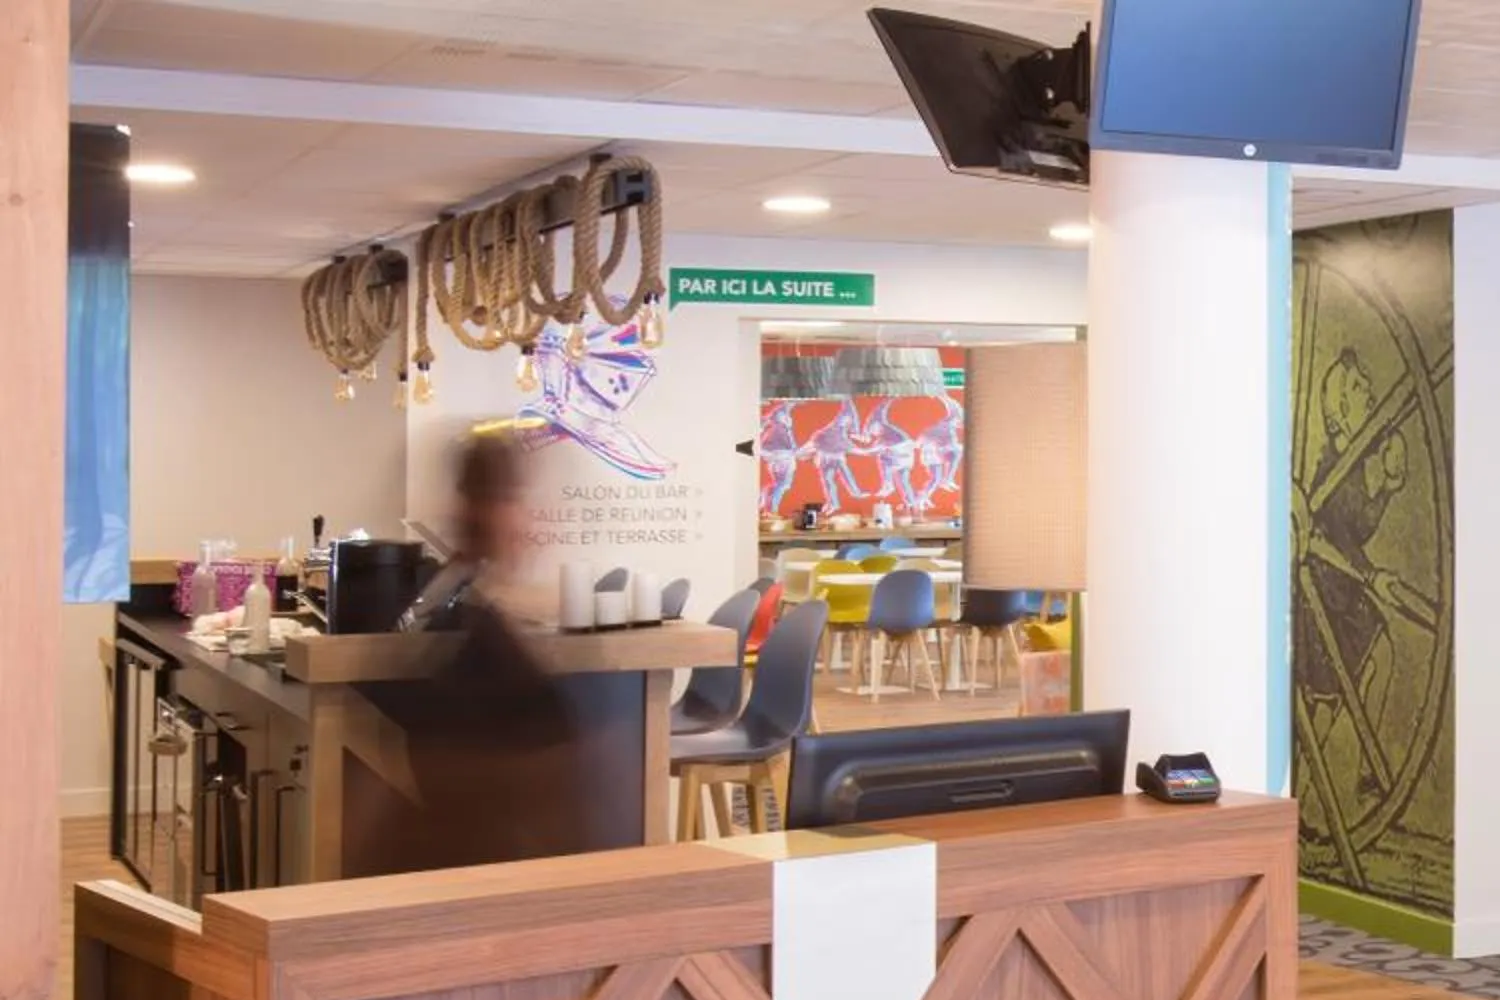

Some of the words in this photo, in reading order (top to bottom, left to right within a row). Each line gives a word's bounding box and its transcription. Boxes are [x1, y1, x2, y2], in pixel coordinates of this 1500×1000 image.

[678, 277, 717, 295] PAR
[720, 279, 748, 296] ICI
[751, 281, 776, 296] LA
[781, 282, 835, 298] SUITE
[561, 484, 621, 500] SALON
[626, 486, 649, 499] DU
[655, 485, 689, 499] BAR
[581, 507, 605, 522] DE
[580, 530, 600, 545] ET
[607, 529, 688, 545] TERRASSE
